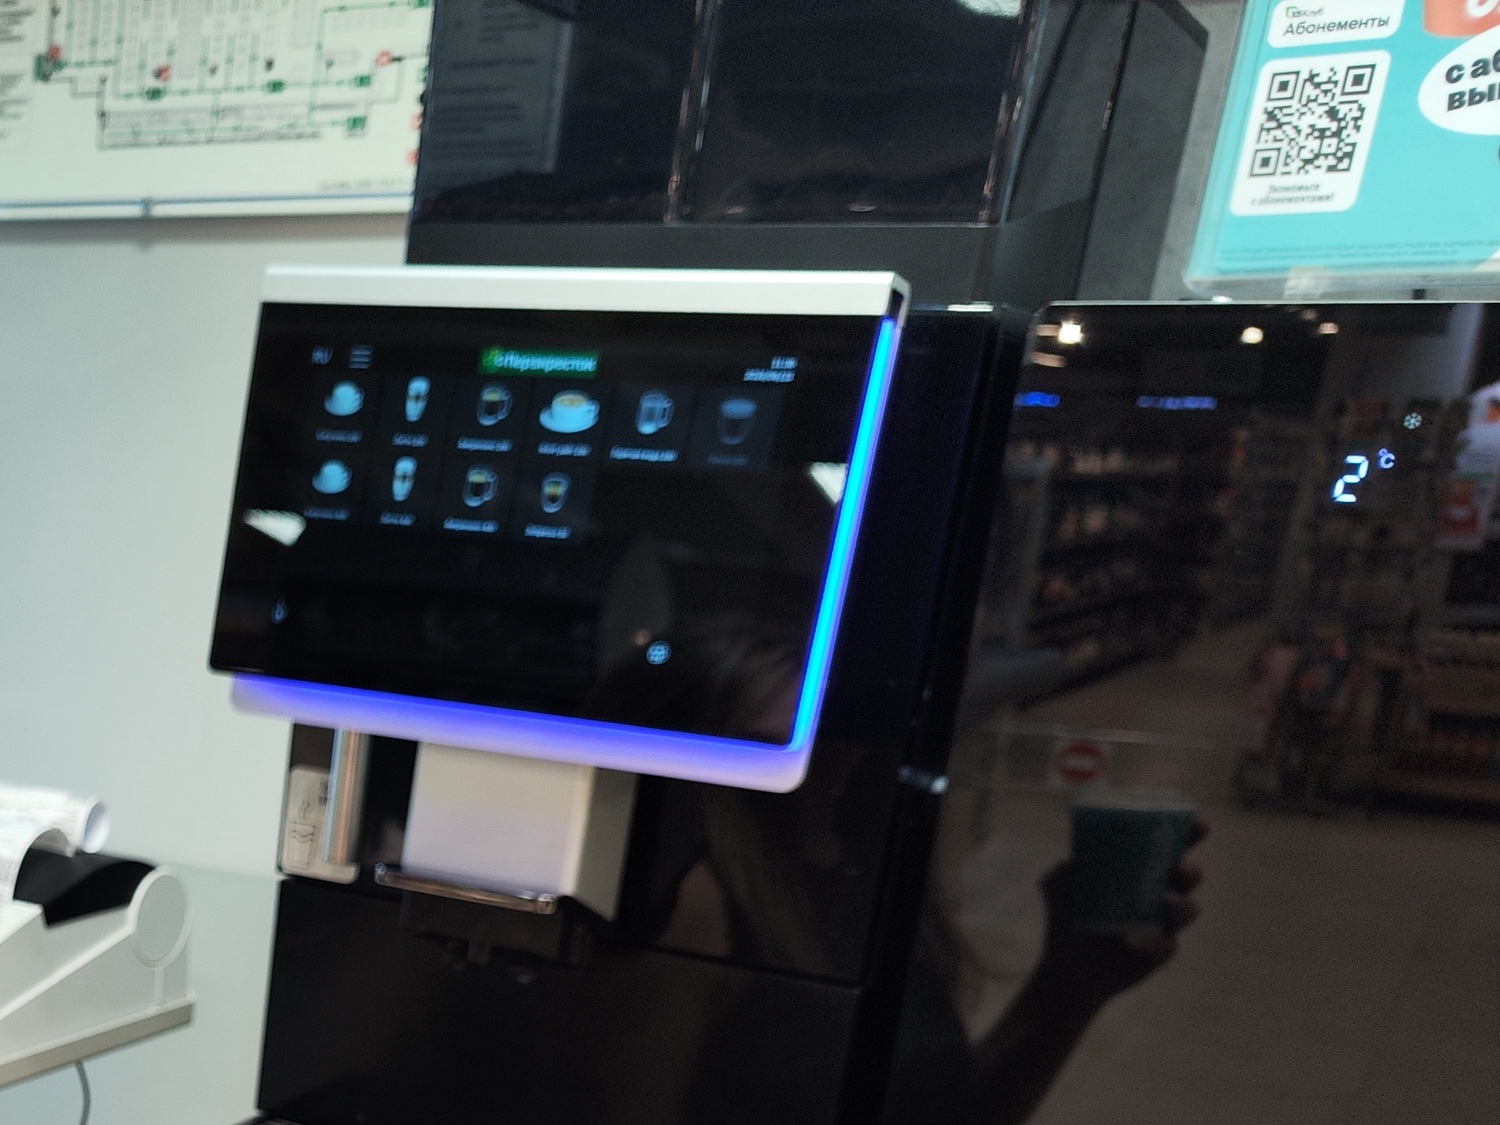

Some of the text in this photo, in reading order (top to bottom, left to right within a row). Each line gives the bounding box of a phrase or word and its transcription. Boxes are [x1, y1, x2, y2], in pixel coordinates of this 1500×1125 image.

[1282, 16, 1390, 36] Абонементы
[1447, 82, 1500, 112] вы
[1331, 455, 1369, 503] 2
